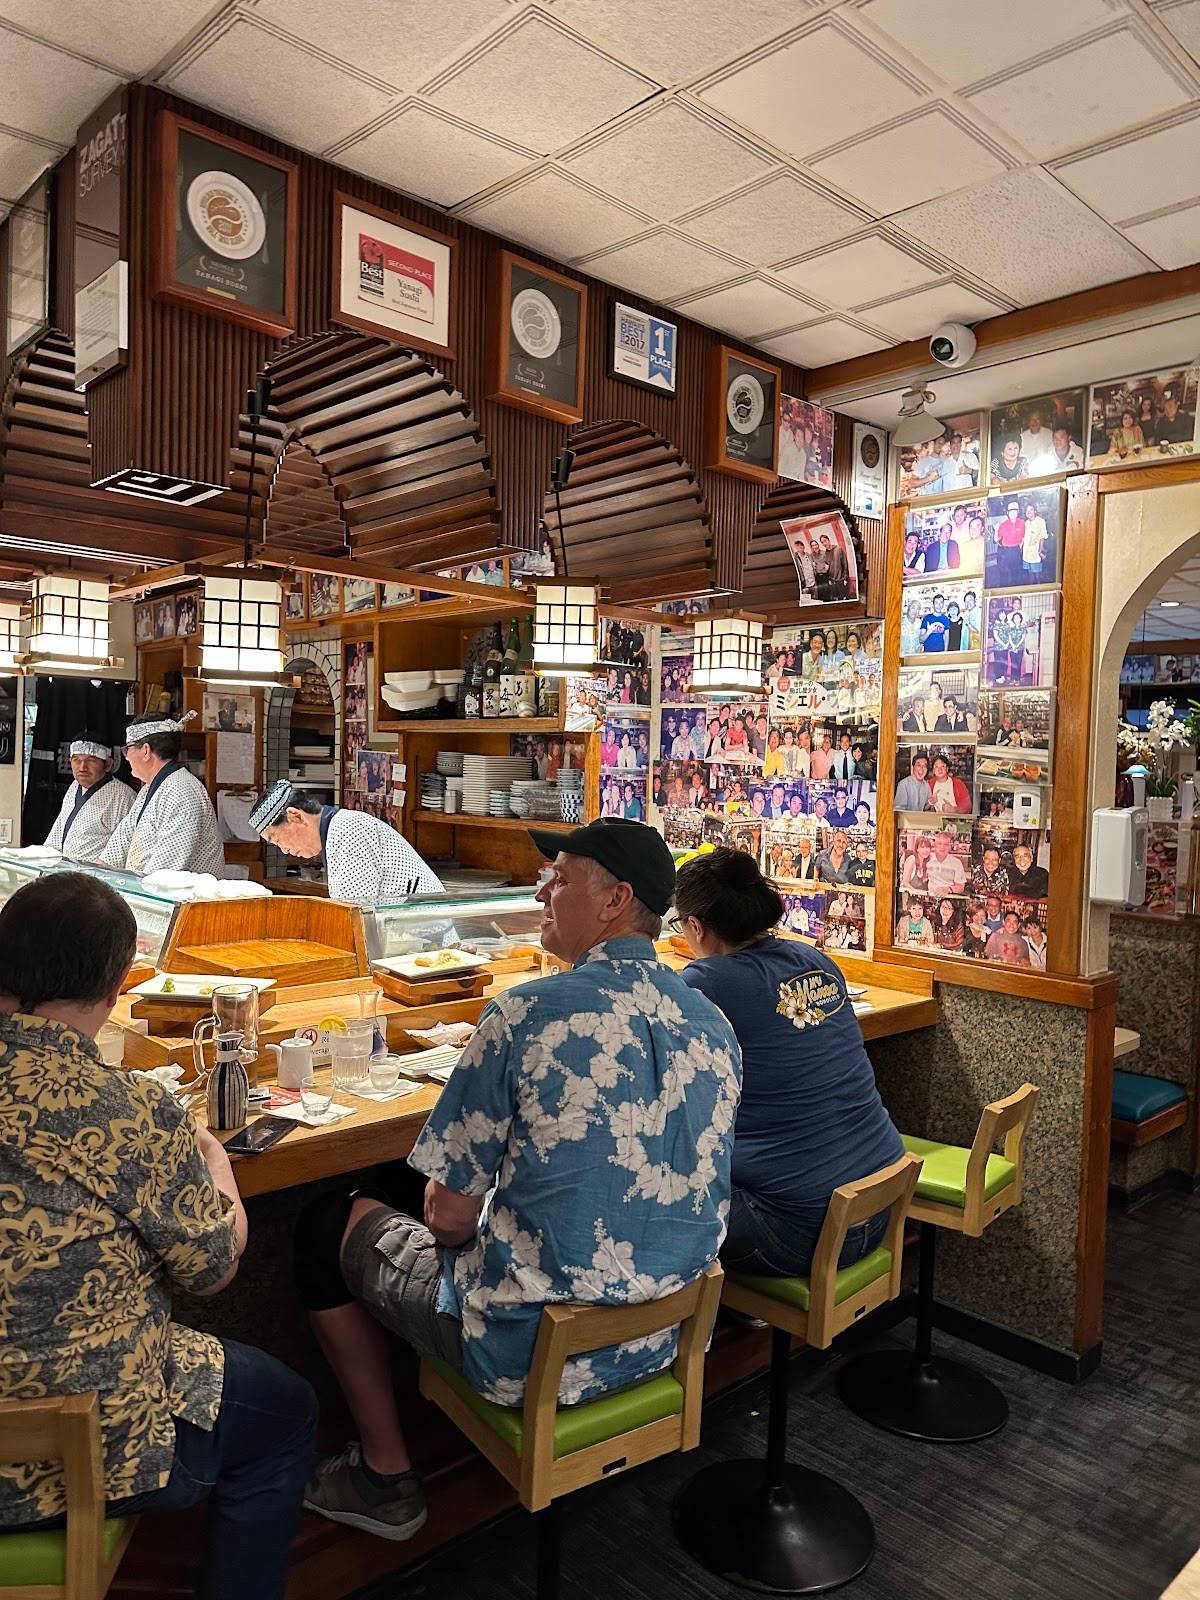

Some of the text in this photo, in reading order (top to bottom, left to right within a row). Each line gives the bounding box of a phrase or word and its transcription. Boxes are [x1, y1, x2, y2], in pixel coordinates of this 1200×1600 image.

[361, 261, 384, 279] Best
[387, 259, 433, 281] SECOND PLACE
[399, 288, 420, 303] Sushi
[621, 322, 645, 341] BEST
[624, 335, 646, 350] 2017
[650, 354, 672, 369] PLACE
